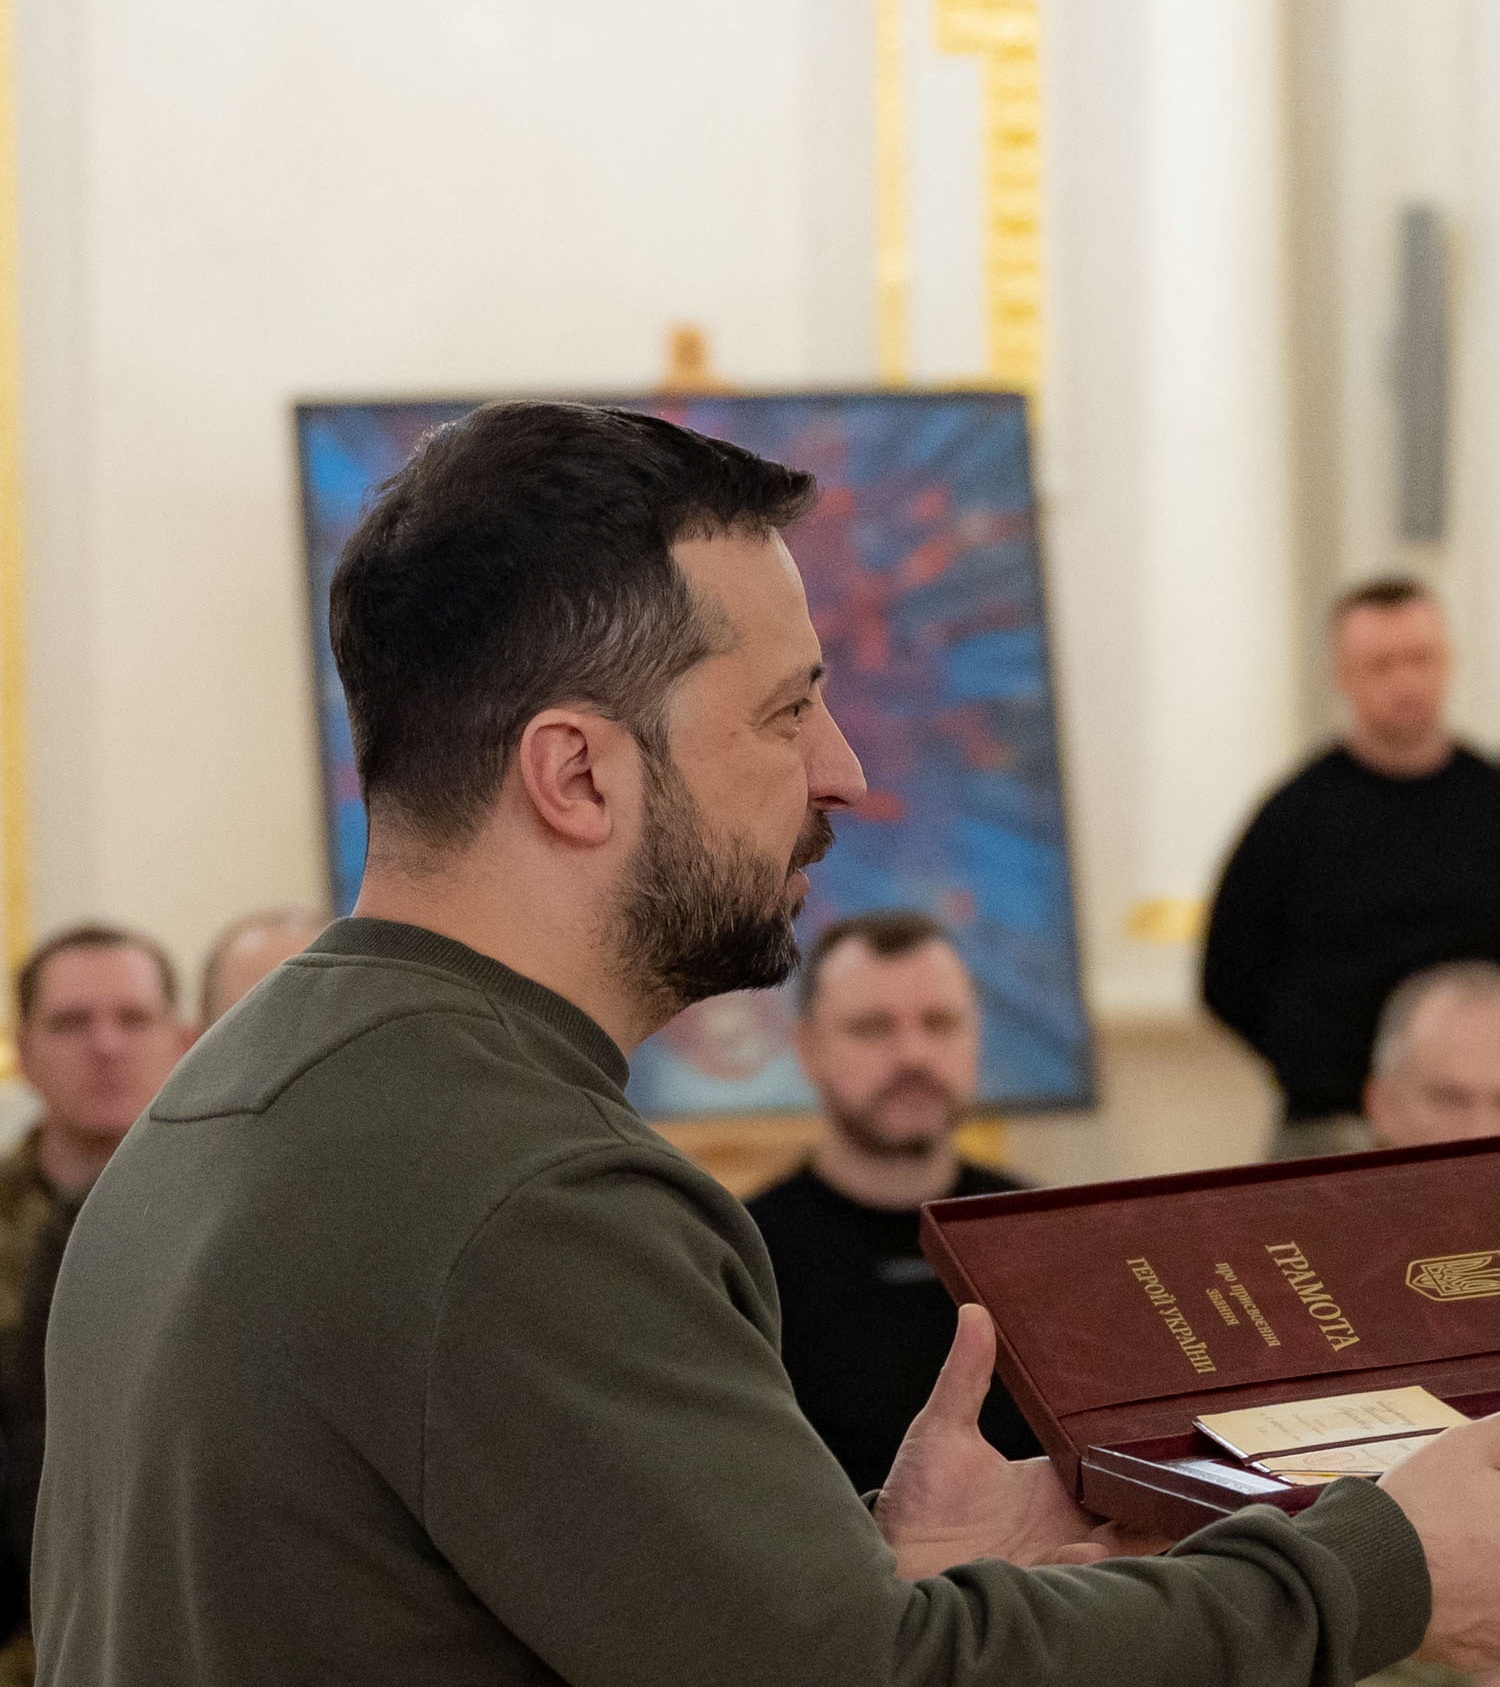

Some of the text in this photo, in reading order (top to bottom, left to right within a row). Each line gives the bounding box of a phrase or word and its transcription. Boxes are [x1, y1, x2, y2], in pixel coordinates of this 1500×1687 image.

[1126, 1257, 1217, 1375] ГЕРОЙ УКРАЇНИ
[1206, 1288, 1241, 1327] звання
[1215, 1262, 1281, 1347] про присвоєння
[1264, 1240, 1361, 1353] ГРАМОТА
